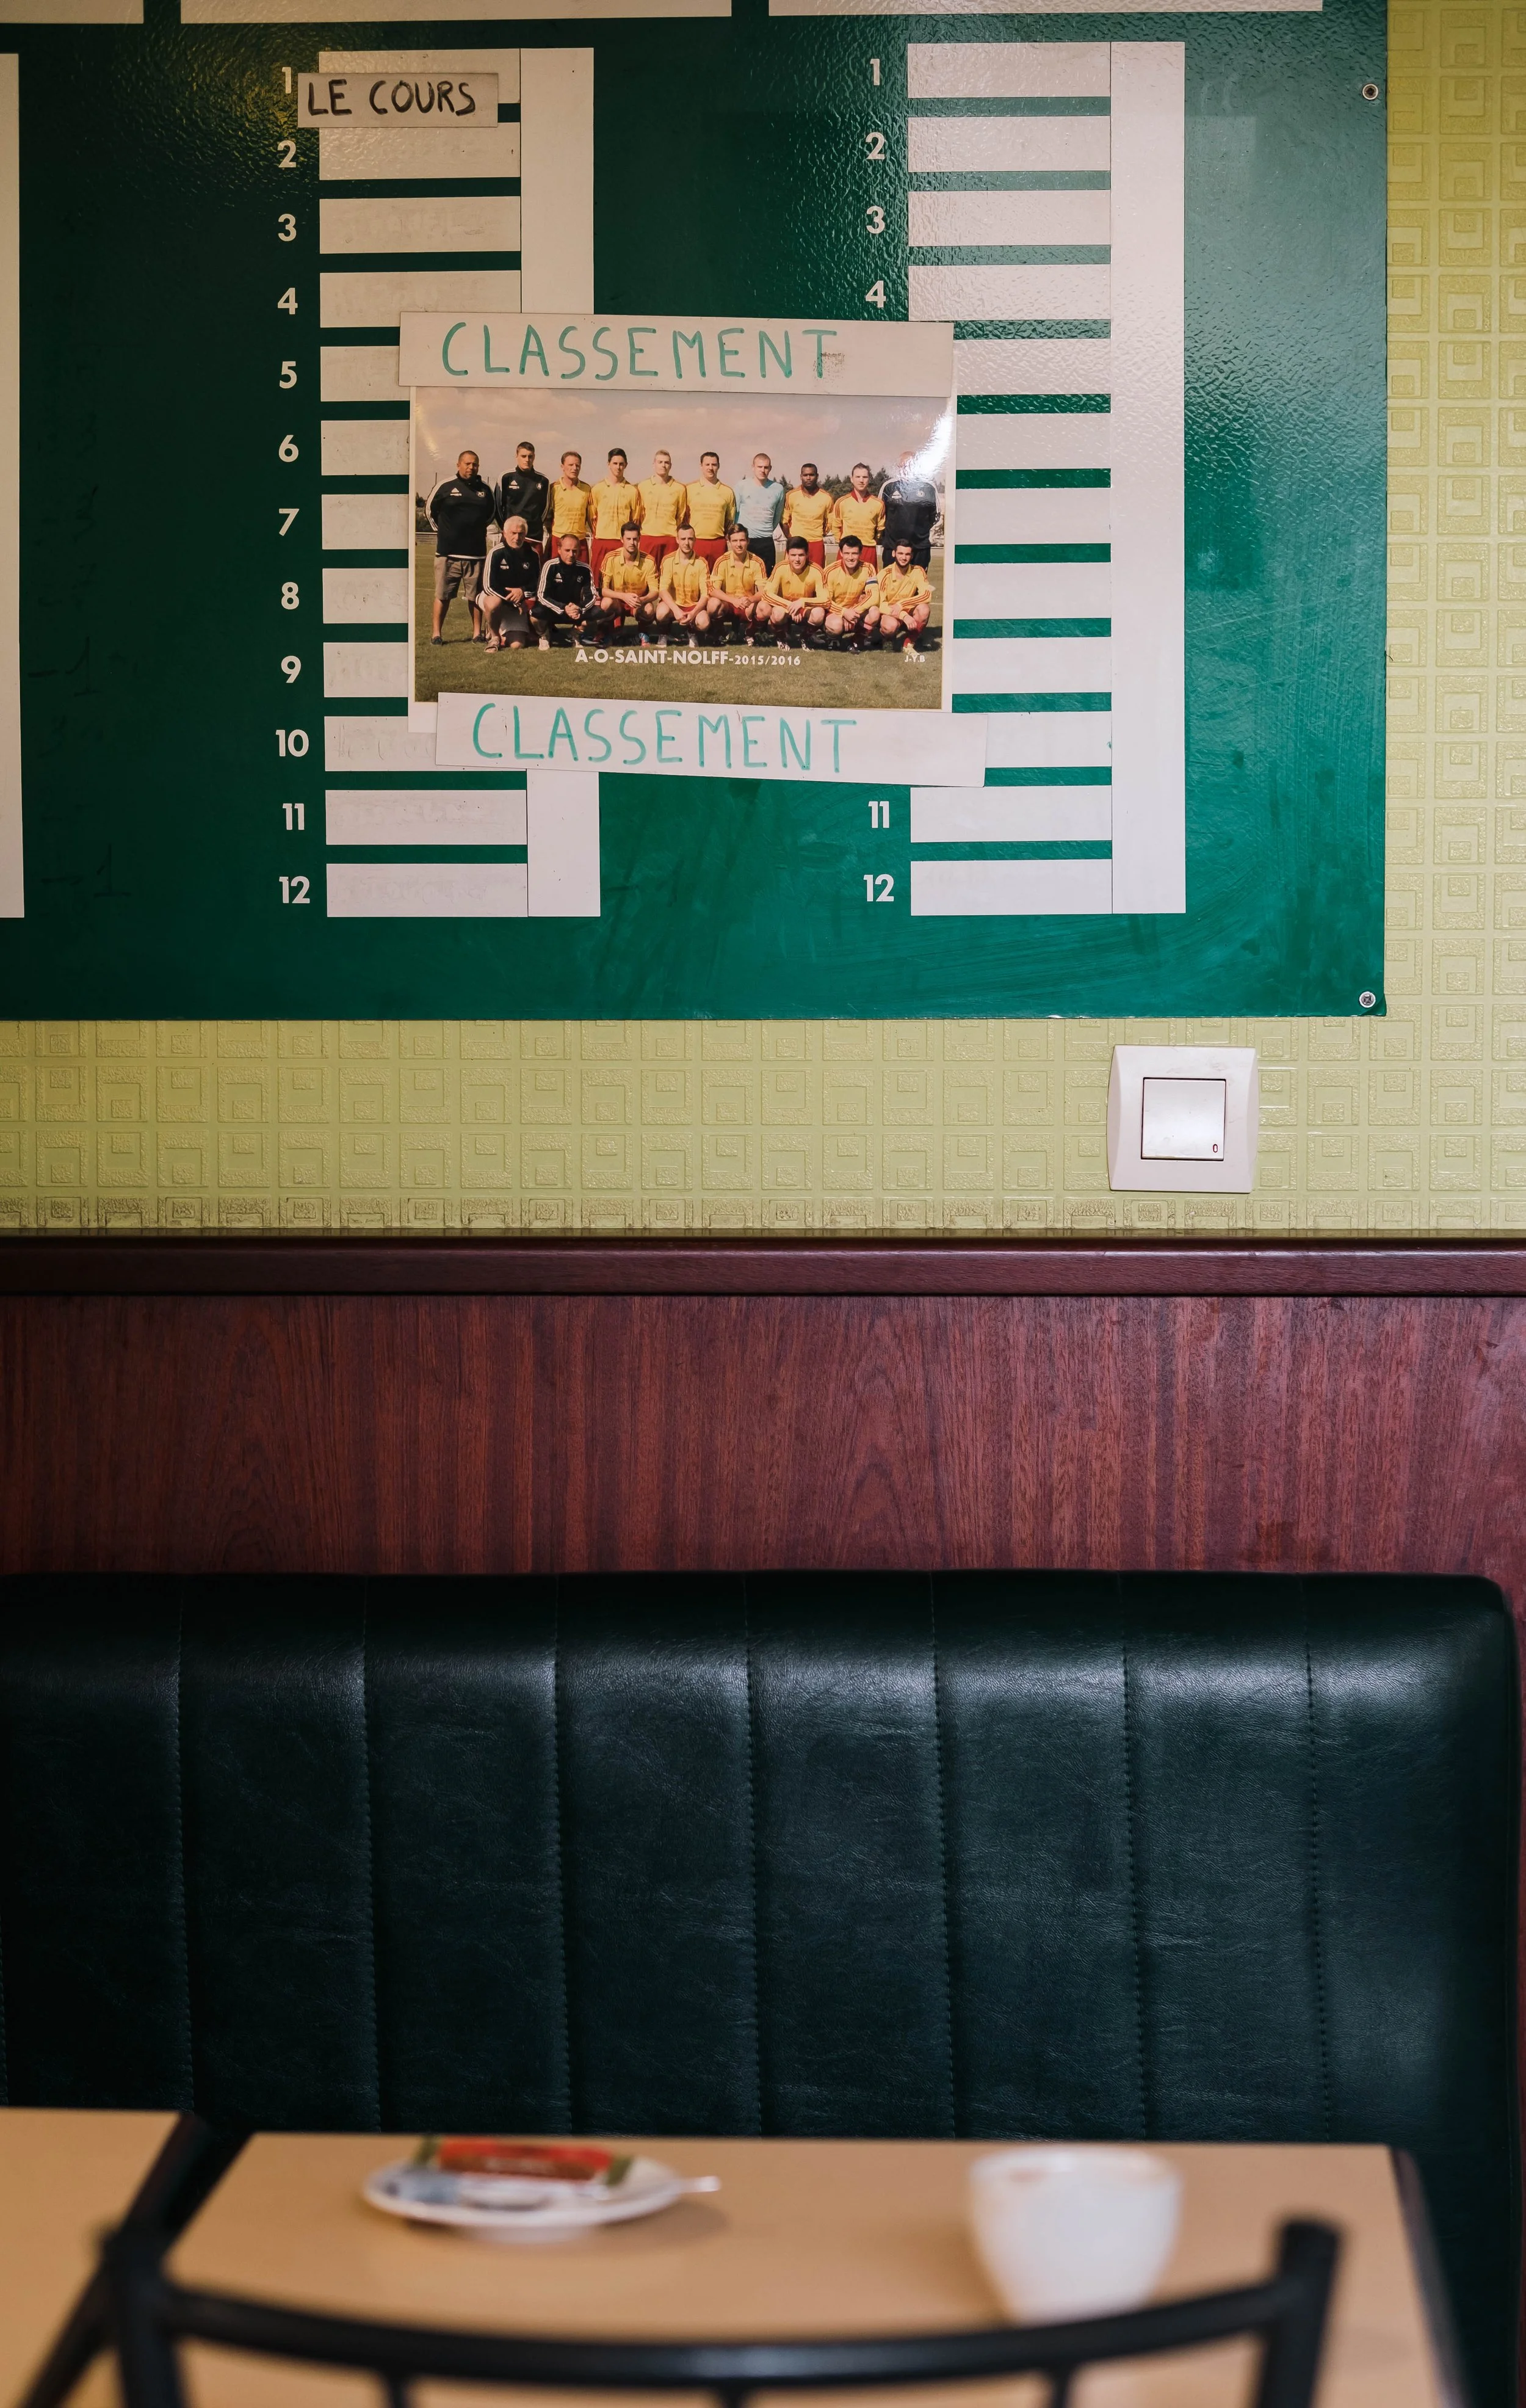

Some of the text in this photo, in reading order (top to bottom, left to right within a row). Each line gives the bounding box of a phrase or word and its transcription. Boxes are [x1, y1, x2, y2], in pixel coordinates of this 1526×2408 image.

[281, 67, 292, 94] 1
[870, 59, 880, 85] 1
[307, 79, 476, 116] LE COURS
[278, 140, 297, 168] 2
[866, 132, 886, 160] 2
[278, 214, 297, 242] 3
[867, 206, 885, 234] 3
[278, 288, 298, 315] 4
[866, 281, 886, 308] 4
[442, 322, 837, 381] CLASSEMENT
[279, 361, 297, 389] 5
[278, 435, 299, 463] 6
[278, 508, 300, 536] 7
[281, 582, 300, 610] 8
[281, 656, 302, 683] 9
[275, 730, 309, 757] 10
[472, 702, 858, 773] CLASSEMENT
[282, 803, 305, 830] 11
[868, 800, 889, 829] 11
[278, 876, 310, 904] 12
[863, 874, 894, 902] 12
